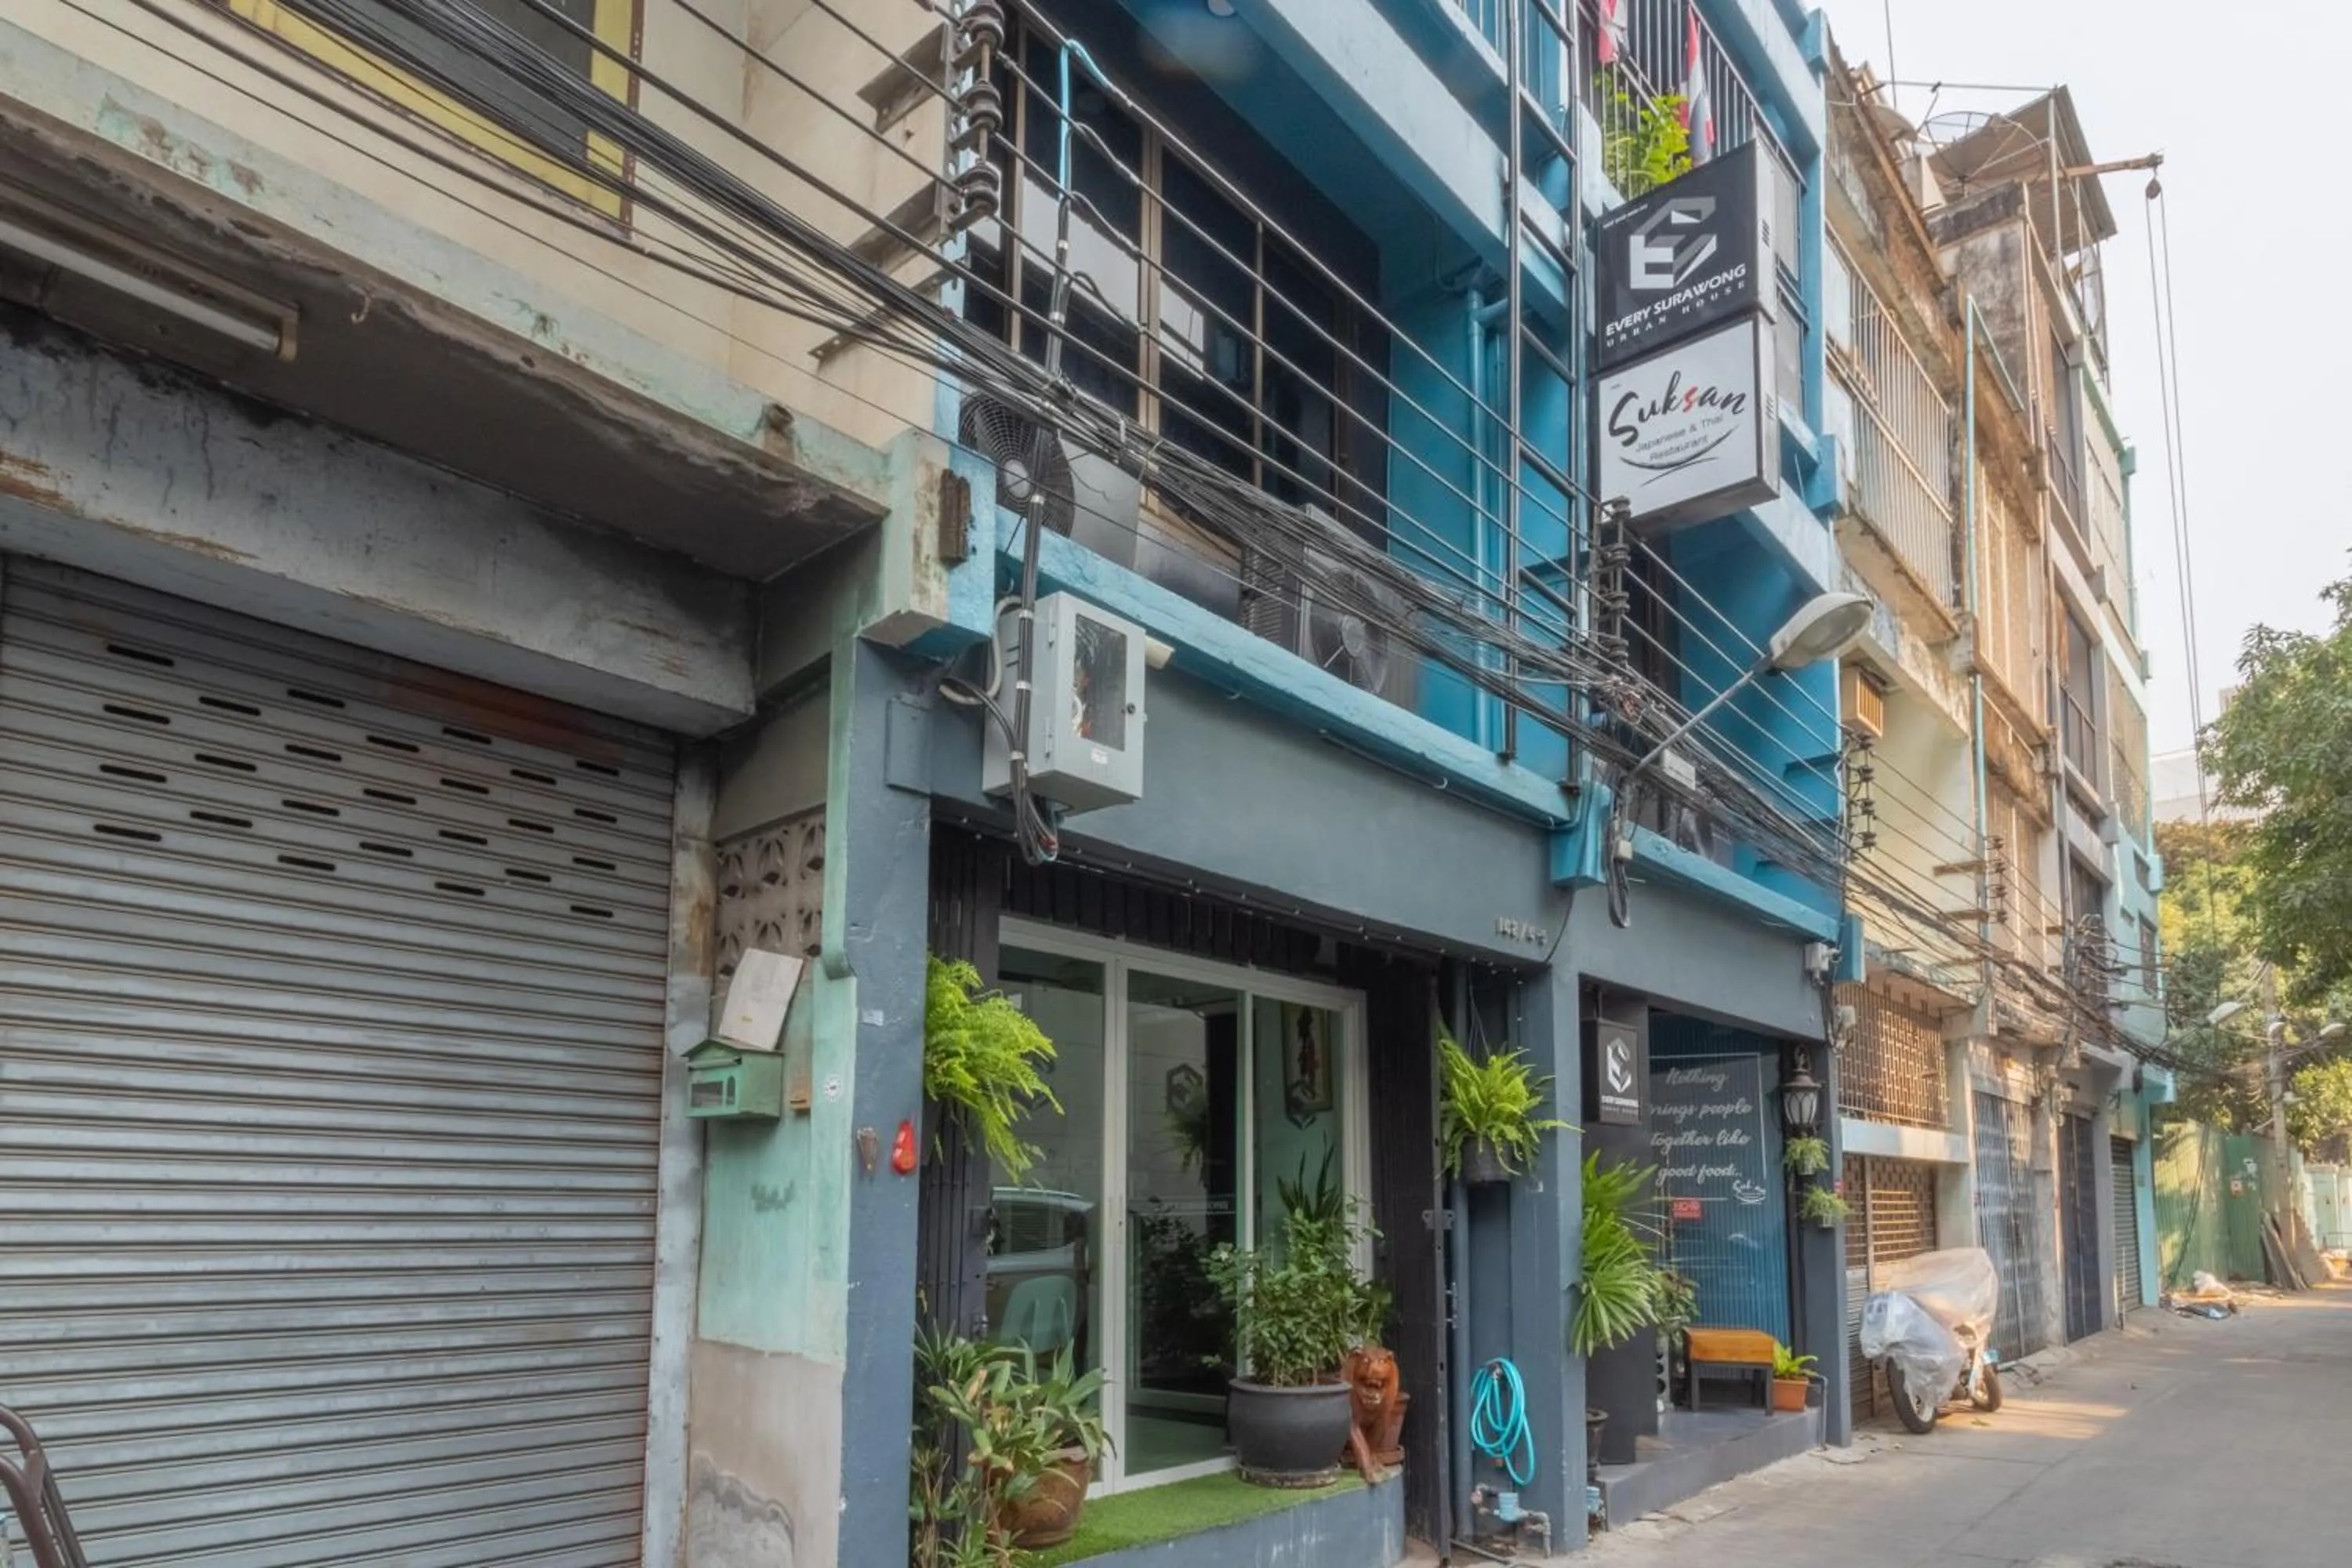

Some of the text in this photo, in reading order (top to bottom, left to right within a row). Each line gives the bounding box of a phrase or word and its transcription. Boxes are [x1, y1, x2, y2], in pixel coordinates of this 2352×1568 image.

[1606, 263, 1746, 336] EVERY SURAWONG
[1607, 280, 1745, 348] URBAN HOUSE
[1608, 370, 1747, 447] Suksan
[1635, 414, 1724, 452] Japanese & Thai
[1649, 434, 1709, 461] Restaurant
[1665, 1067, 1729, 1092] Nothing
[1698, 1097, 1753, 1120] people
[1650, 1128, 1751, 1155] together like
[1655, 1164, 1697, 1187] good
